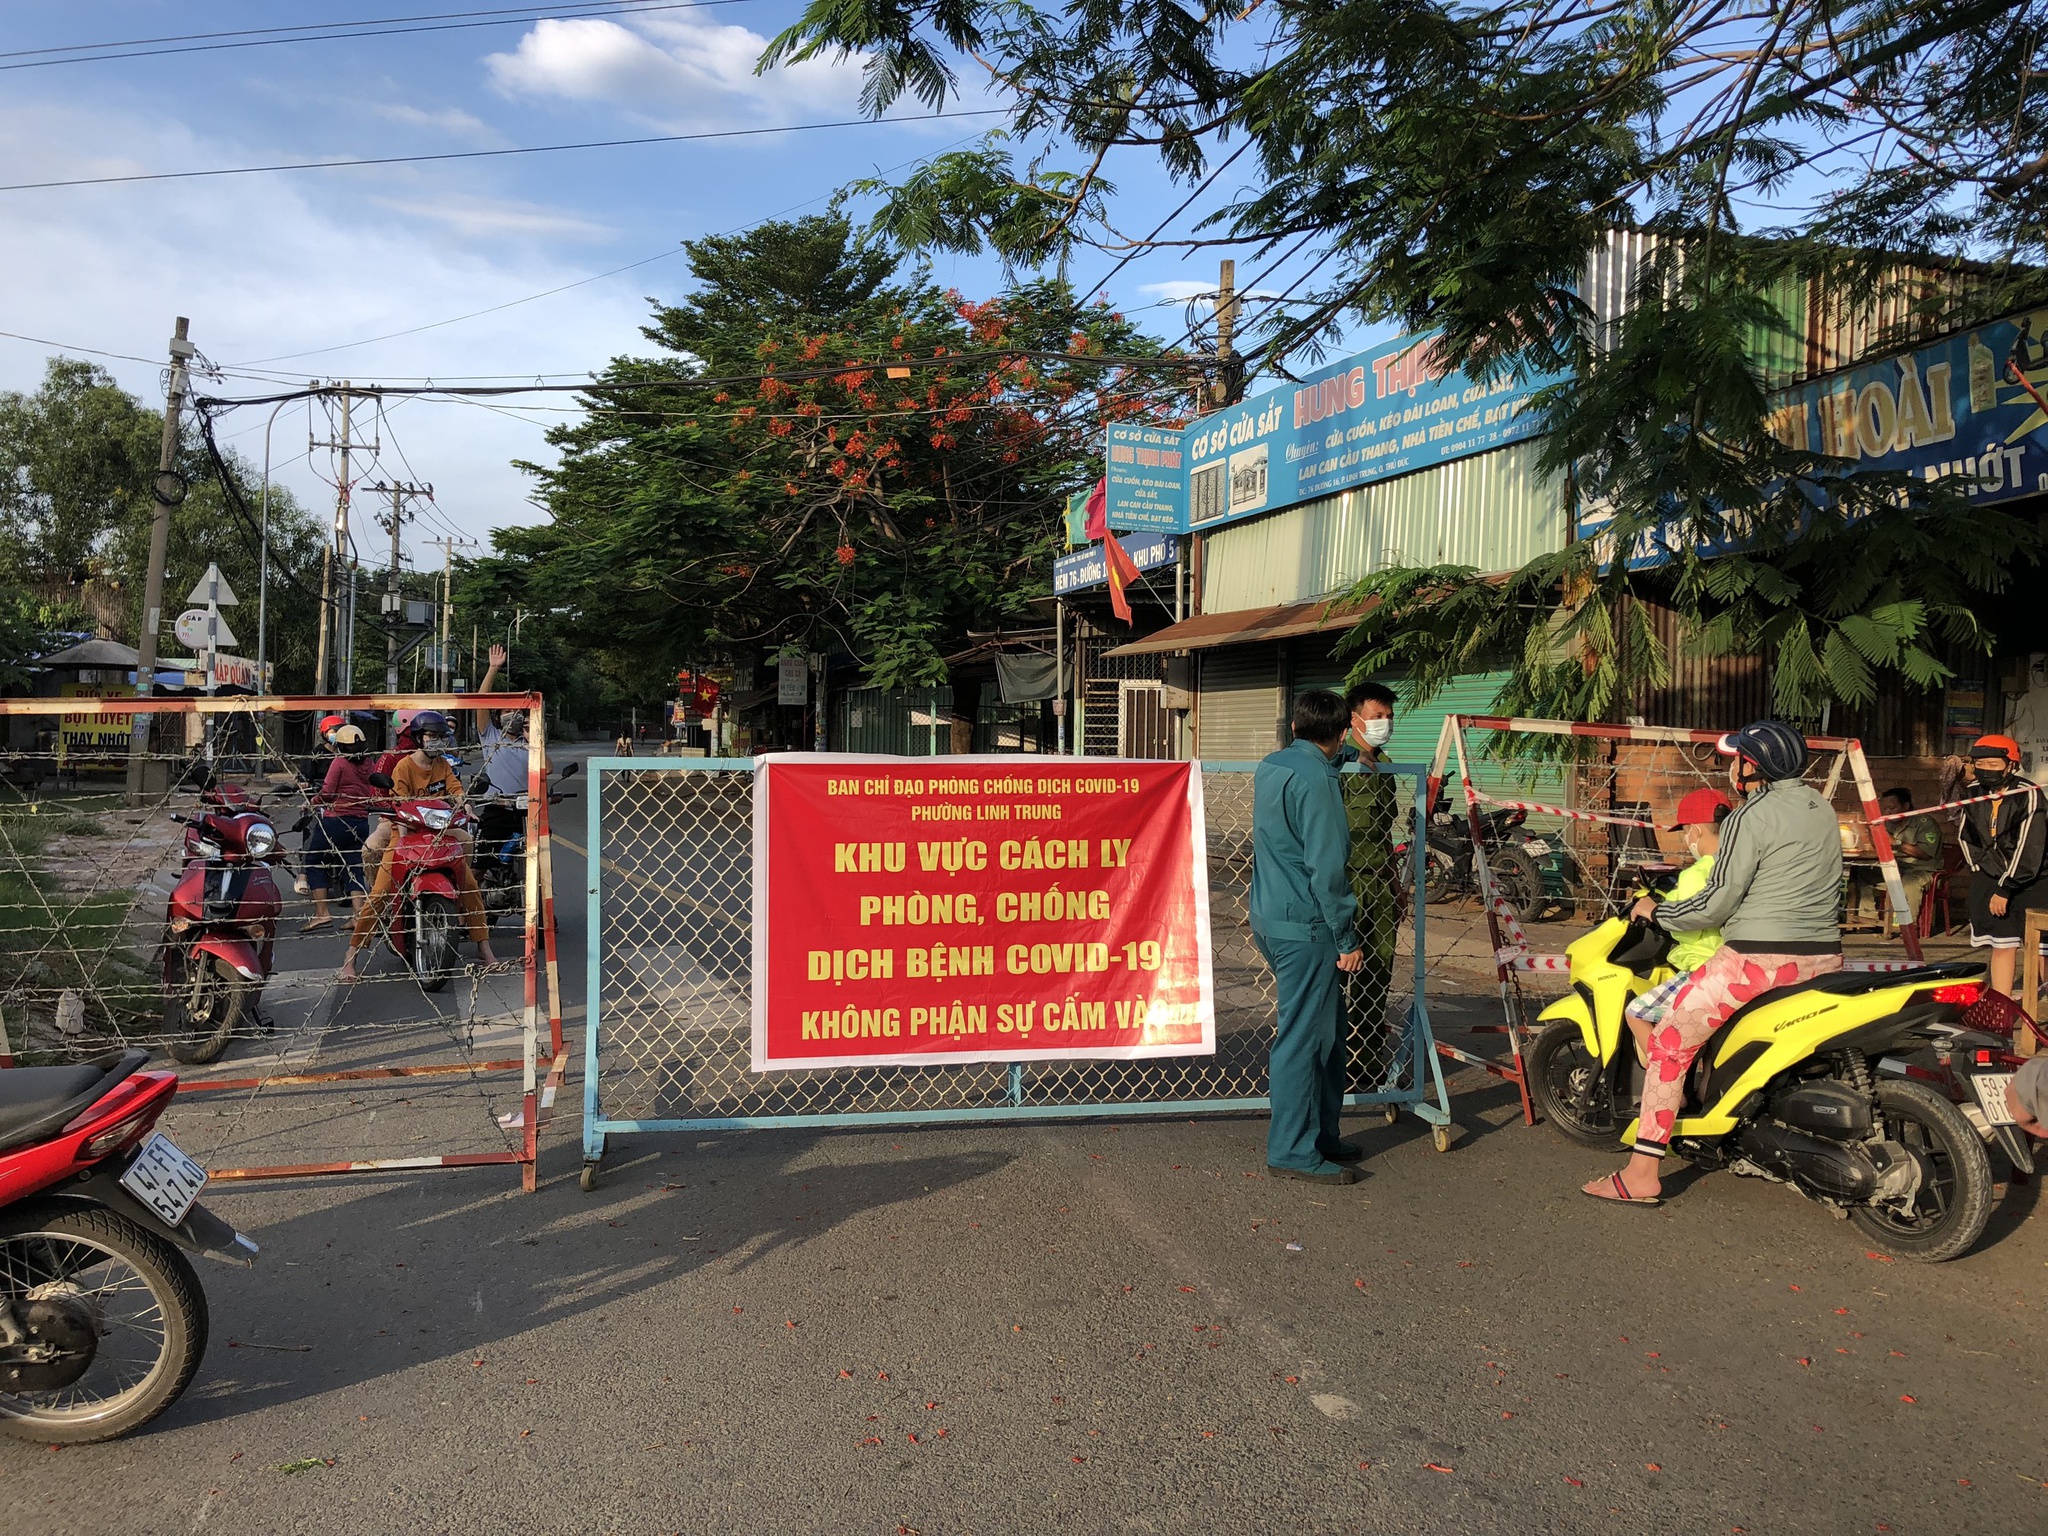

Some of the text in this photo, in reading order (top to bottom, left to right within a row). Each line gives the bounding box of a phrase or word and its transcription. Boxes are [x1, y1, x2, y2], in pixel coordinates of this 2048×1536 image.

[1293, 334, 1461, 430] HƯNG THỊN
[1191, 395, 1283, 461] CƠ SỞ CỬA SẮT
[1818, 354, 1956, 460] HOÀI
[1113, 429, 1128, 440] CƠ
[1128, 430, 1142, 442] SỞ
[1143, 431, 1162, 444] CỬA
[1325, 428, 1344, 449] CỬA
[1379, 411, 1402, 431] KÉO
[1298, 466, 1317, 481] LAN
[1318, 457, 1338, 475] CAN
[1401, 426, 1426, 450] NHÀ
[1055, 568, 1068, 591] HẺM
[1069, 571, 1077, 587] 76
[1080, 561, 1101, 585] ĐƯỜNG
[1133, 547, 1149, 568] KHU
[1150, 535, 1167, 562] PHỐ
[1168, 540, 1175, 559] 5
[62, 731, 93, 745] THAY
[827, 774, 1140, 798] BAN CHỈ ĐẠO PHÒNG CHỐNG DỊCH COVID-19
[911, 802, 1062, 821] PHƯỜNG LINH TRUNG
[834, 835, 1132, 877] KHU VỰC CÁCH LY
[859, 881, 1111, 927] PHÒNG, CHỐNG
[807, 941, 1162, 986] DỊCH BỆNH COVID-19
[1597, 973, 1618, 981] HONDA
[801, 991, 1168, 1041] KHÔNG PHẬN SỰ CẤM VÀ
[1773, 1011, 1819, 1034] VARIO
[153, 1160, 204, 1220] 547.40
